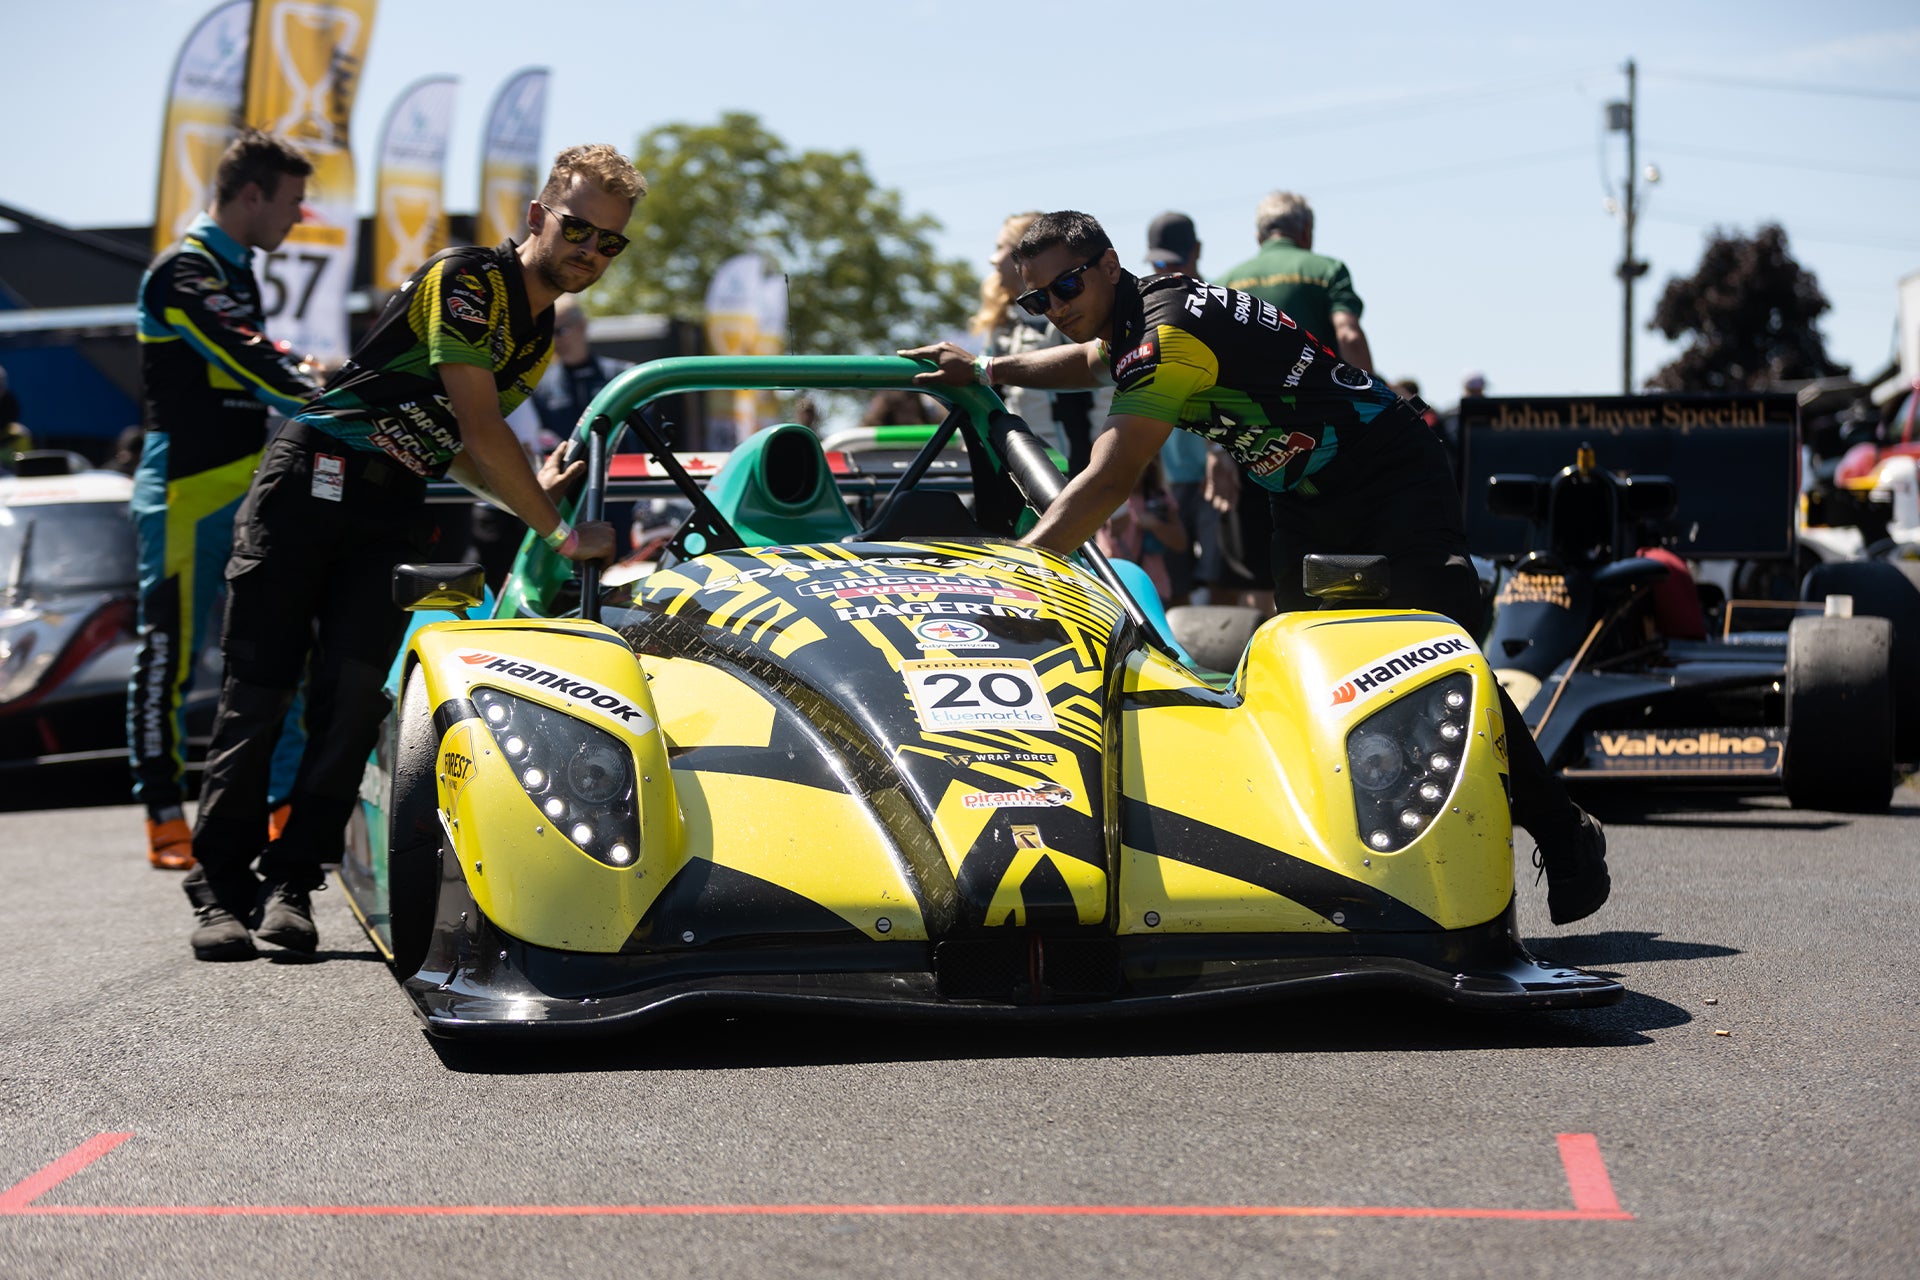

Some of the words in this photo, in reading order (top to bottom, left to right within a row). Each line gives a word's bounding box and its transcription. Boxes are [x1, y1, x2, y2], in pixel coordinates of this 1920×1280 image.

[264, 253, 330, 320] 57
[1491, 403, 1561, 430] John
[1570, 402, 1656, 435] Player
[1662, 401, 1765, 435] Special
[809, 575, 989, 594] LINCOLN
[855, 584, 1018, 599] WELDERS
[835, 601, 1041, 622] HAGERTY
[915, 661, 1022, 669] RADICAL
[923, 672, 1034, 709] 20
[1600, 731, 1768, 756] Valvoline
[444, 752, 473, 779] FOREST
[1015, 753, 1055, 762] FORCE
[964, 790, 1048, 807] piranha
